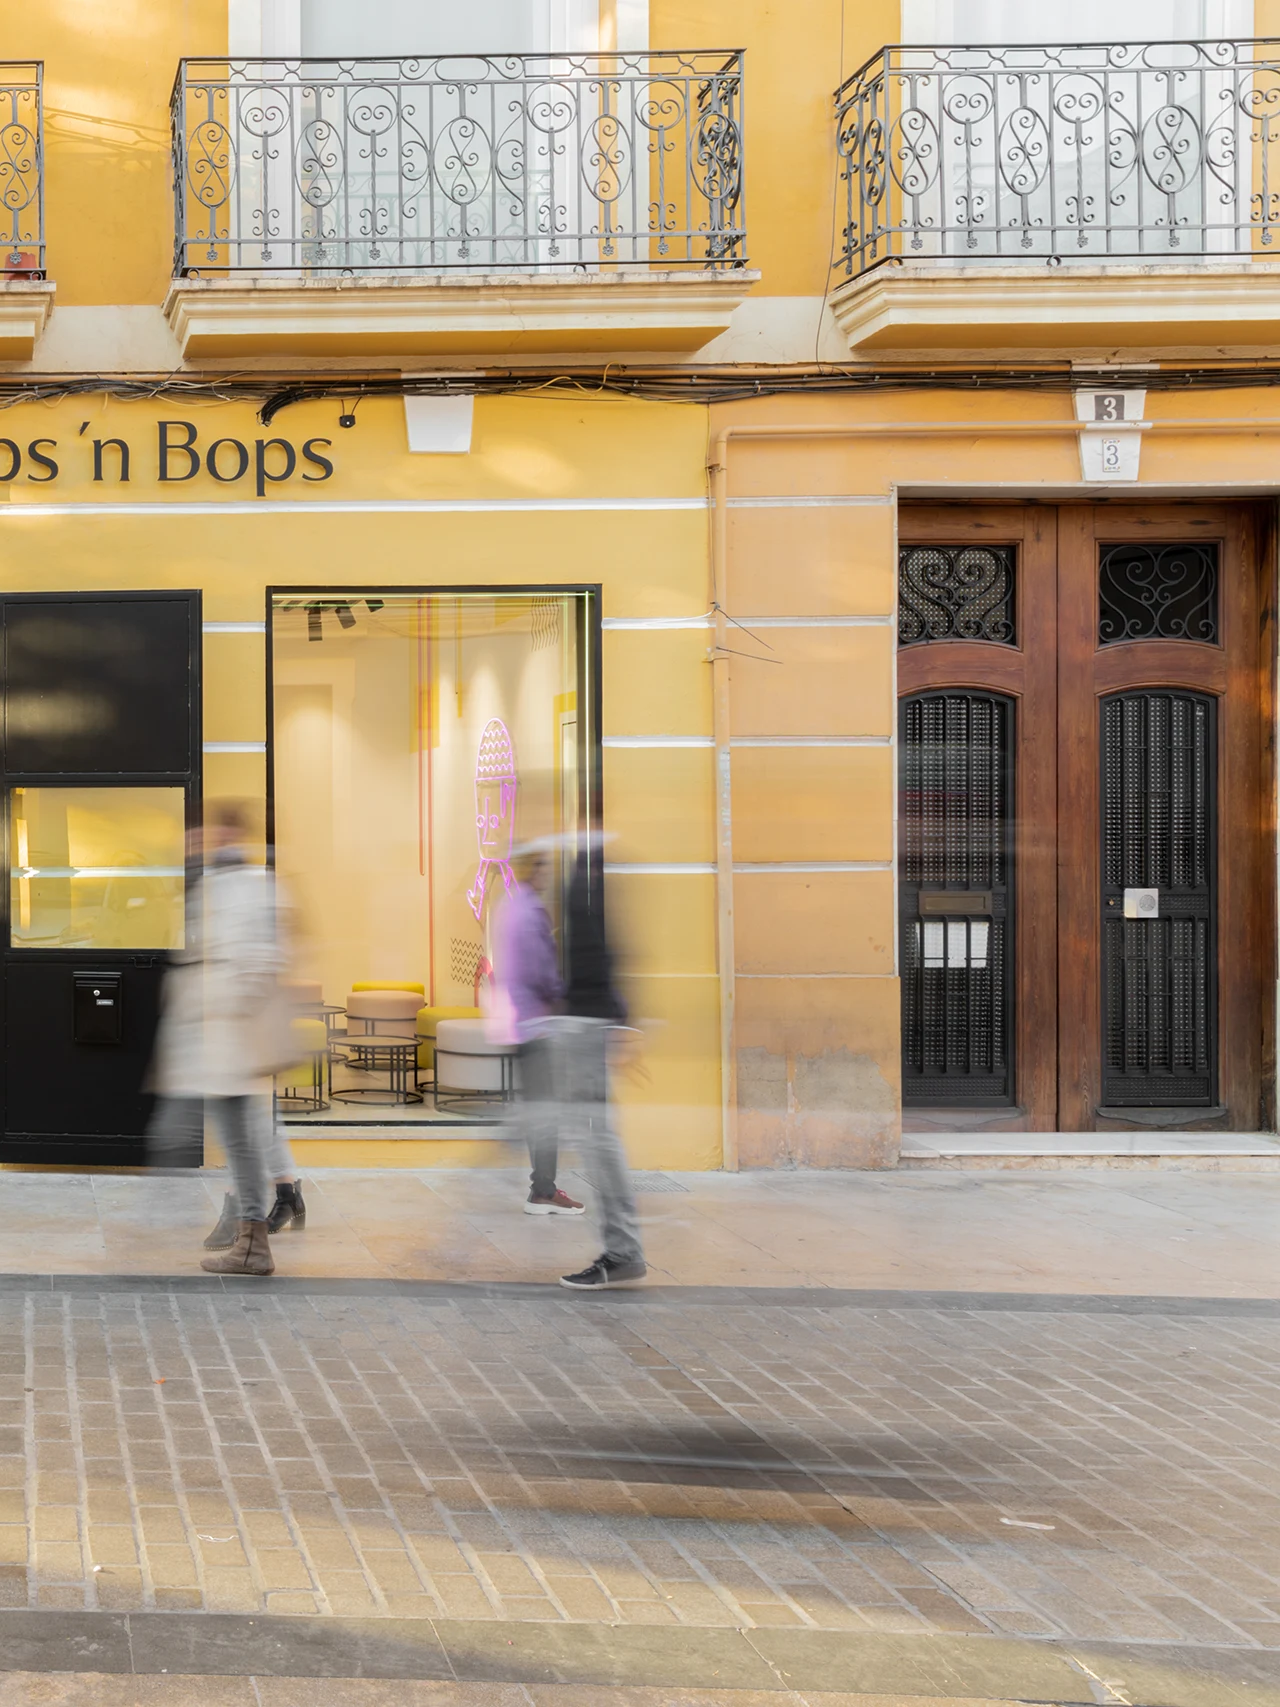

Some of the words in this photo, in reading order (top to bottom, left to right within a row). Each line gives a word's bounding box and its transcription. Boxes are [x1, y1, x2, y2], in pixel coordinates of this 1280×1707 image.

[1103, 397, 1117, 420] 3
[157, 420, 334, 496] Bops
[1106, 444, 1119, 466] 3
